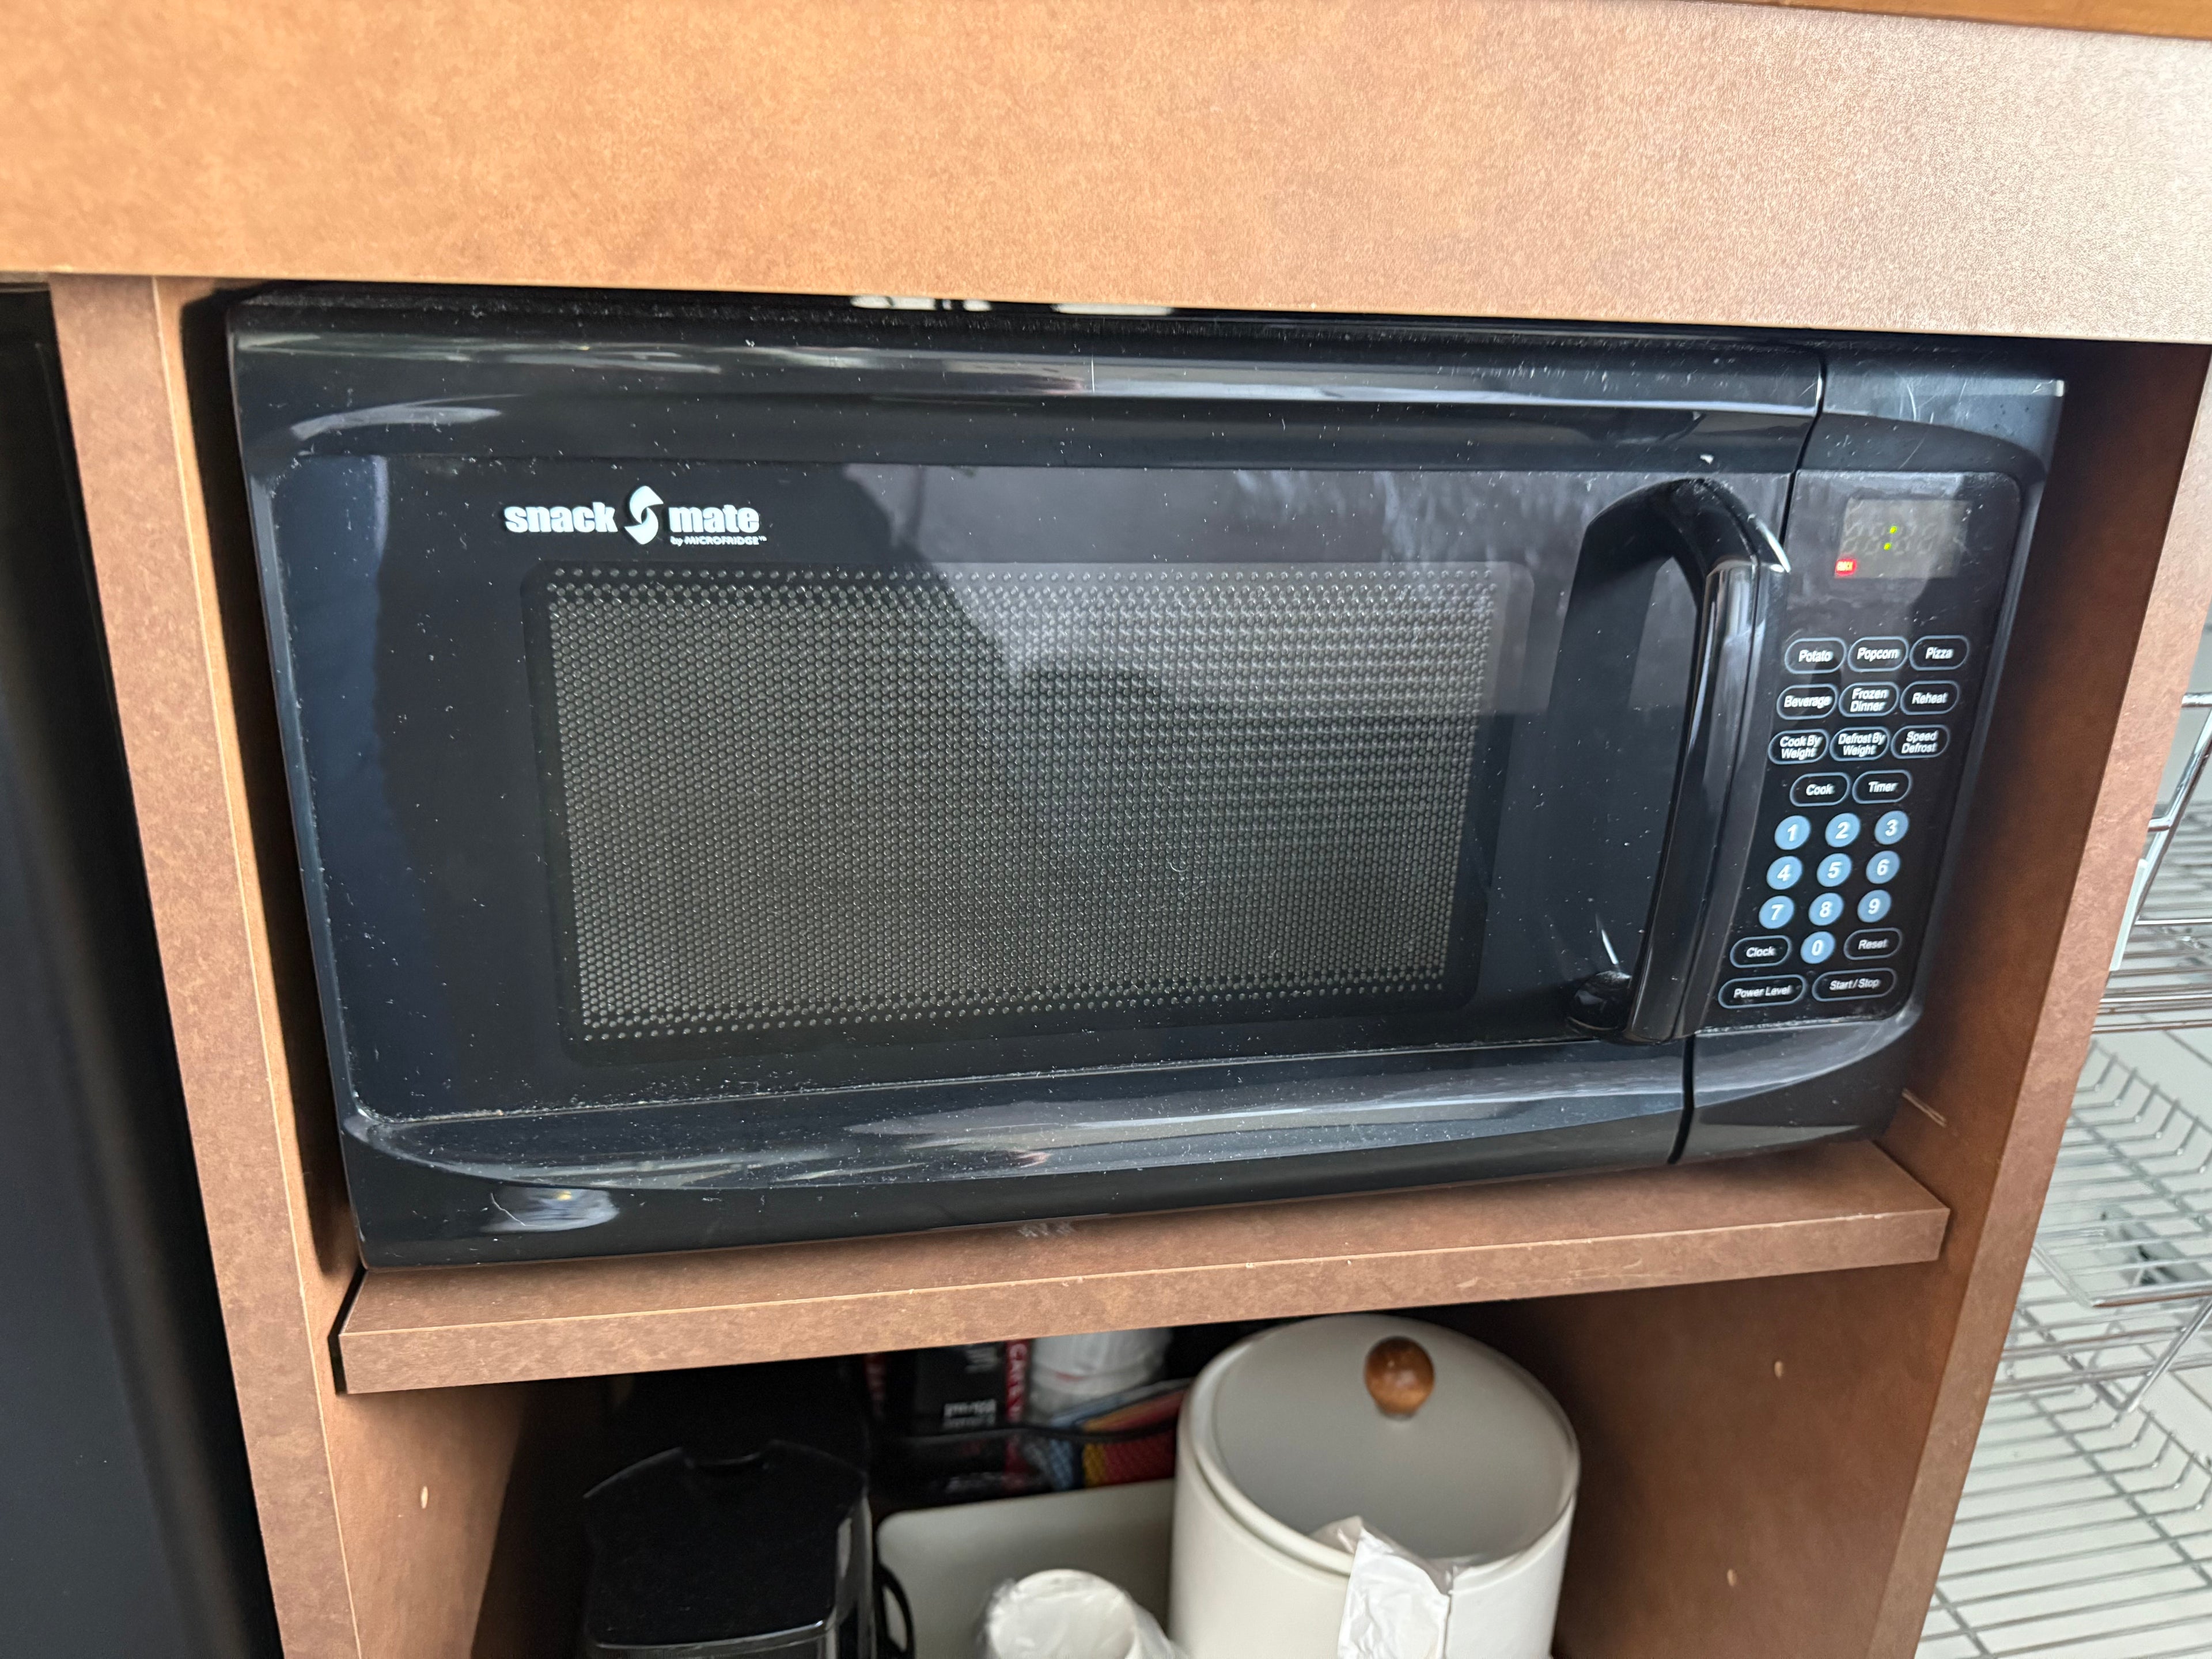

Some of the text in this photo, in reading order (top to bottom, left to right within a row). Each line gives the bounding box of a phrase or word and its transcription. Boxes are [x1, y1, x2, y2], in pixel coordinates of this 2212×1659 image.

[503, 502, 760, 533] snack mate
[671, 536, 683, 547] by
[1798, 649, 1834, 662] Potato
[1857, 647, 1900, 662] Popcorn
[1925, 646, 1955, 660] Pizza
[1852, 688, 1889, 700] Frozen
[1912, 692, 1948, 704] Reheat
[1784, 695, 1833, 709] Beverage
[1850, 701, 1885, 713] Dinner
[1779, 734, 1822, 748] Cook By
[1838, 733, 1886, 745] Defrost By
[1906, 730, 1938, 744] Speed
[1781, 748, 1817, 761] Weight
[1843, 745, 1878, 758] Weight
[1902, 742, 1938, 754] Defrost
[1806, 783, 1835, 797] Cook
[1868, 781, 1899, 793] Timer
[1787, 824, 1798, 841] 1
[1835, 821, 1850, 839] 2
[1885, 819, 1898, 836] 3
[1777, 865, 1791, 881] 4
[1828, 862, 1842, 879] 5
[1877, 859, 1890, 876] 6
[1771, 904, 1785, 921] 7
[1819, 901, 1832, 918] 8
[1868, 899, 1881, 915] 9
[1812, 939, 1823, 956] 0
[1858, 938, 1889, 950] Reset
[1746, 946, 1775, 957] Clock
[1830, 980, 1854, 990] Start
[1858, 978, 1880, 989] Stop
[1733, 986, 1791, 999] Power Level
